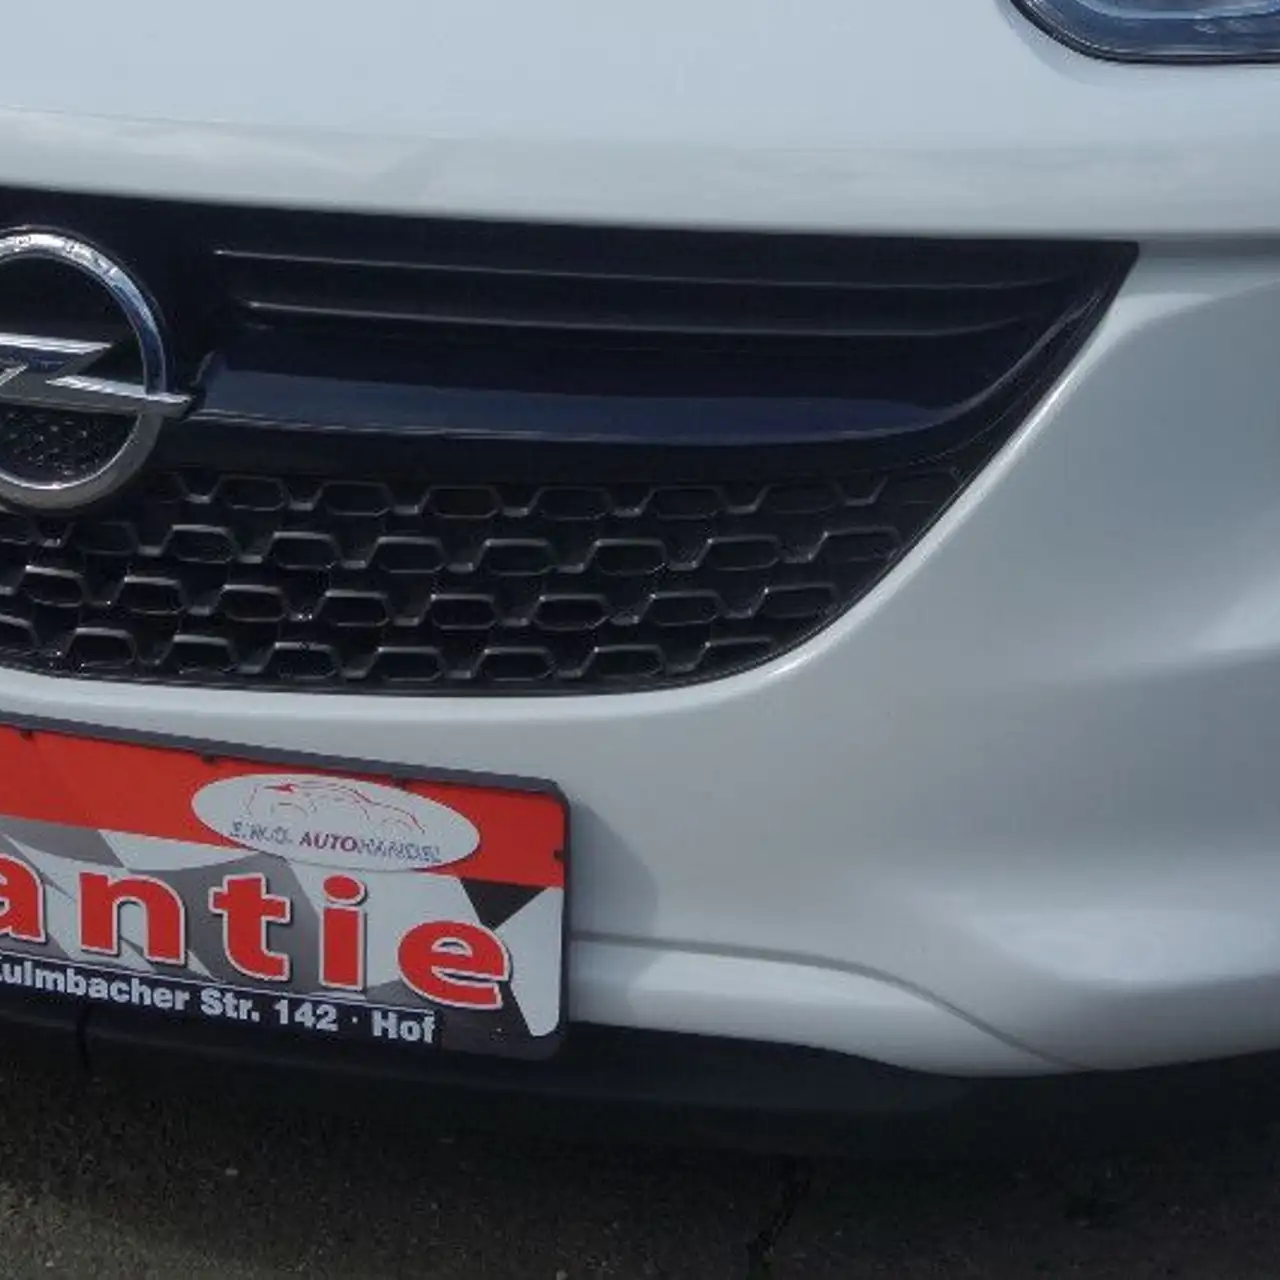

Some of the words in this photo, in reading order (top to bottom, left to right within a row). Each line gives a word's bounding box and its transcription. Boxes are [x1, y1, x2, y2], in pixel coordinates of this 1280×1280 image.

[298, 831, 443, 863] AUTOHANDEL
[199, 986, 261, 1023] Str.
[273, 998, 339, 1032] 142
[372, 1009, 436, 1044] Hof
